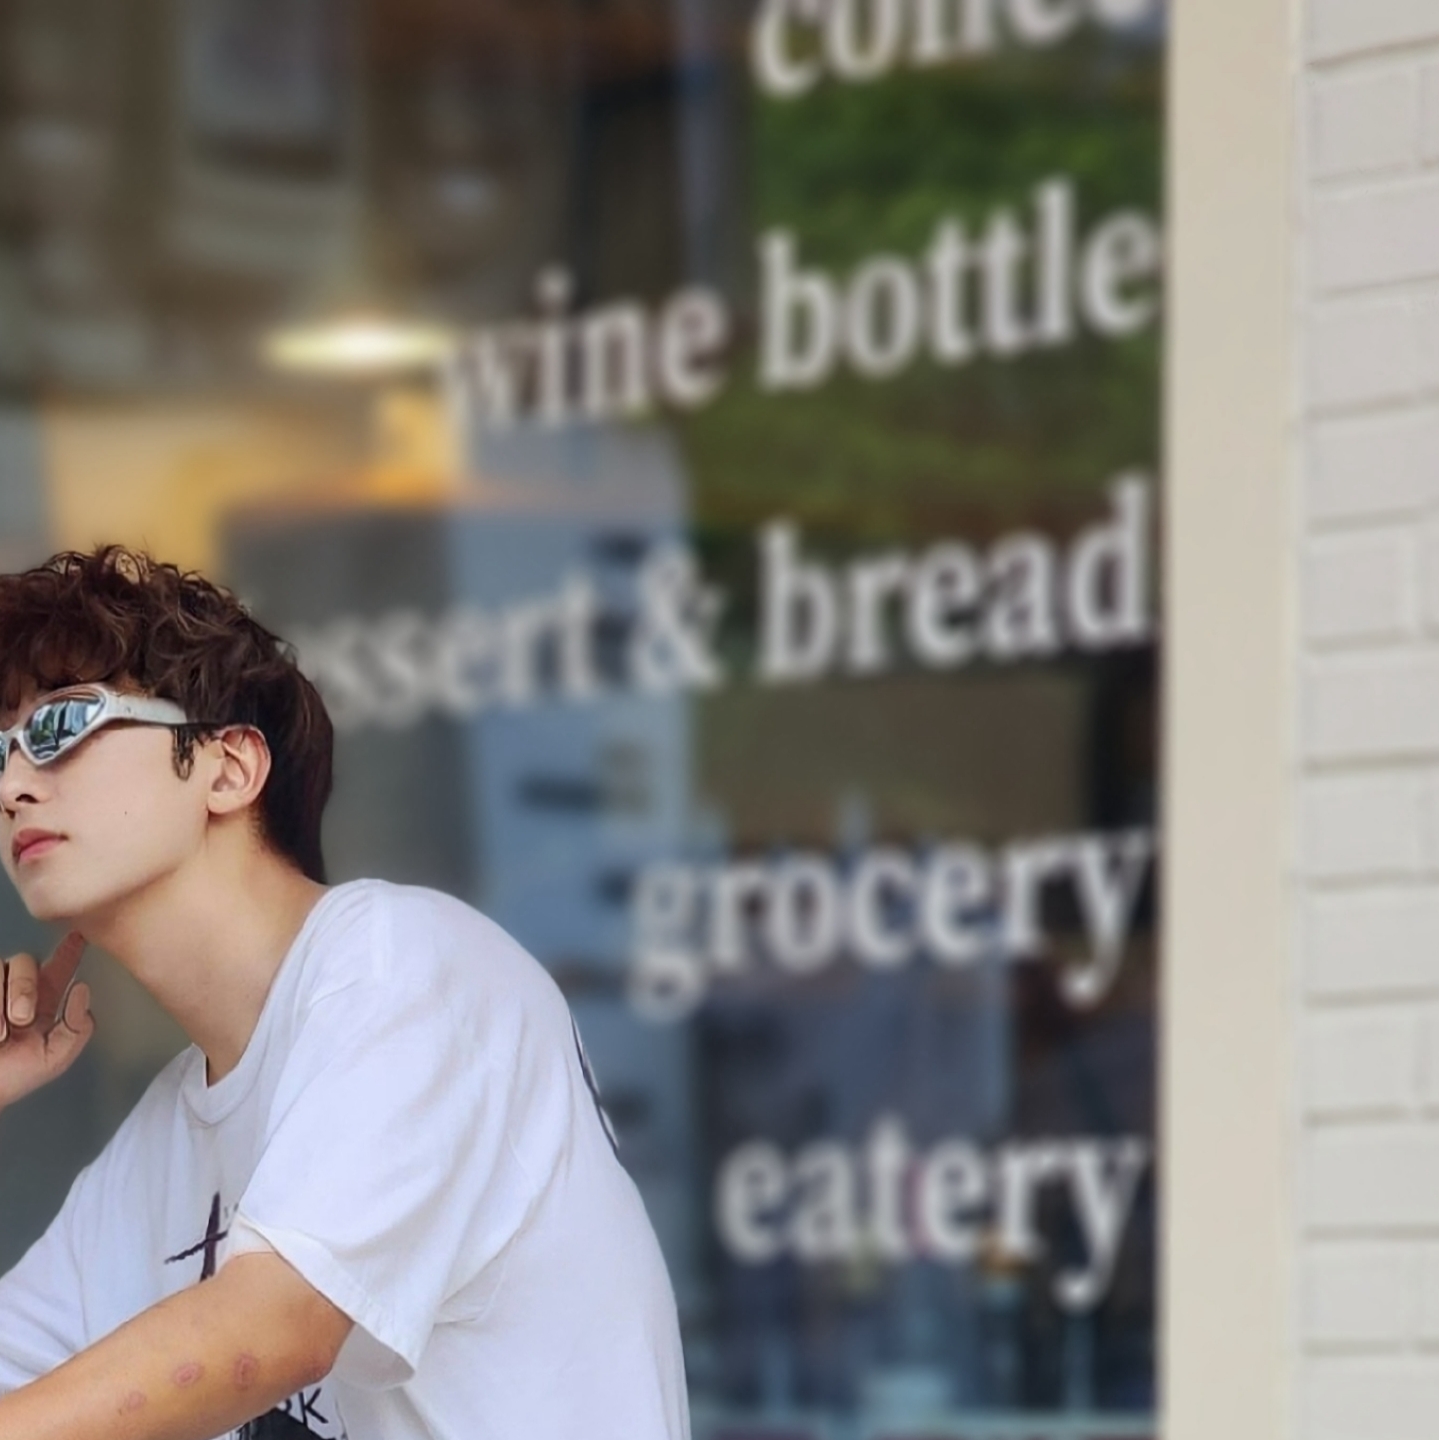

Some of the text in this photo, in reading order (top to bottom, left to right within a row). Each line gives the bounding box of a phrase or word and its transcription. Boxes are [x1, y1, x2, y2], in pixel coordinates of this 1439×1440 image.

[444, 178, 1160, 430] wine bottle
[298, 475, 1150, 726] ssert & bread
[630, 825, 1150, 1022] grocery
[716, 1113, 1146, 1310] eatery
